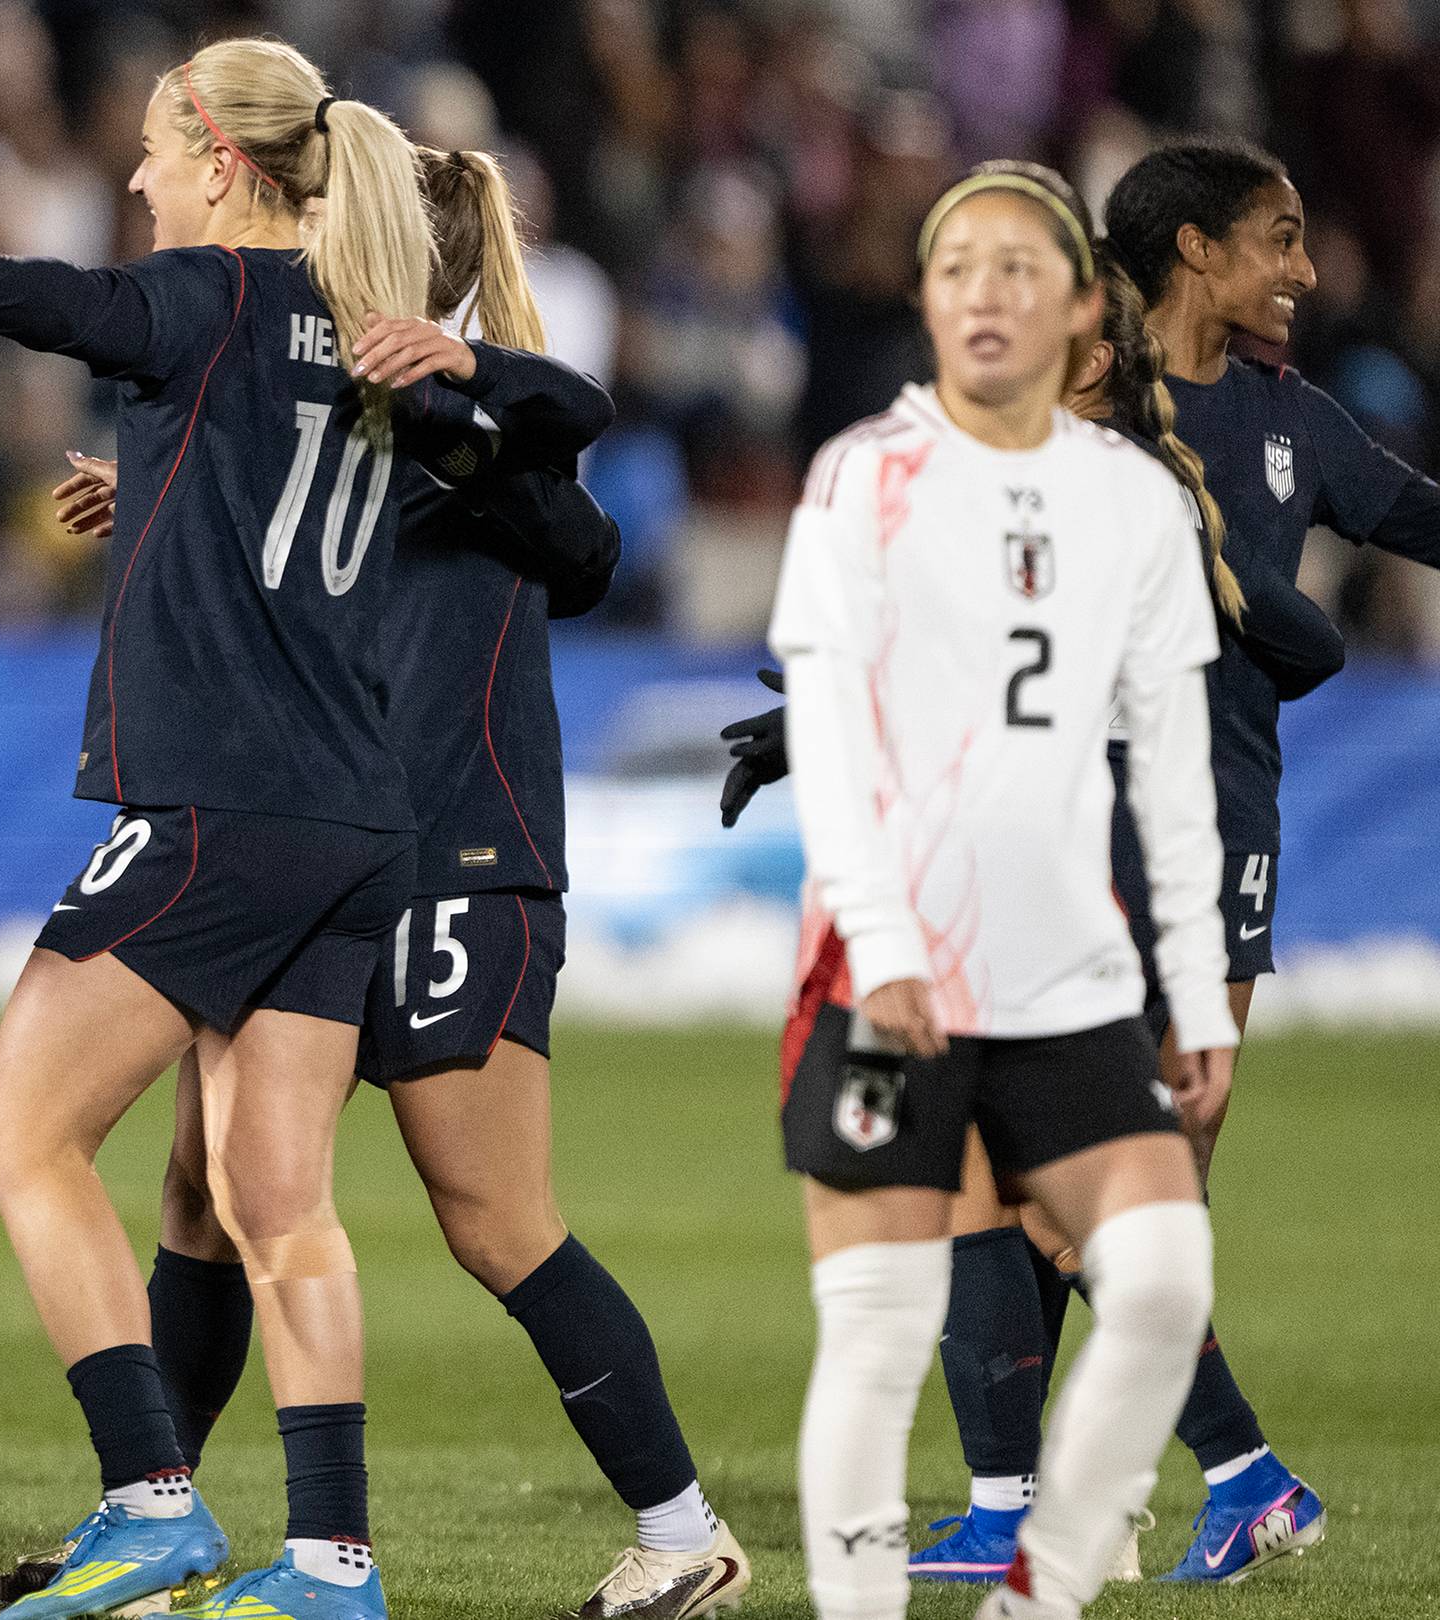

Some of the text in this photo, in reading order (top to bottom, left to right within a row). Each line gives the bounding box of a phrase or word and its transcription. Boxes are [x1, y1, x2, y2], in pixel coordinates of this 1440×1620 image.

[288, 313, 339, 367] HE
[1267, 445, 1291, 472] USA
[262, 400, 394, 597] 10
[1007, 627, 1052, 727] 2
[1239, 854, 1270, 912] 4
[394, 897, 470, 1008] 15
